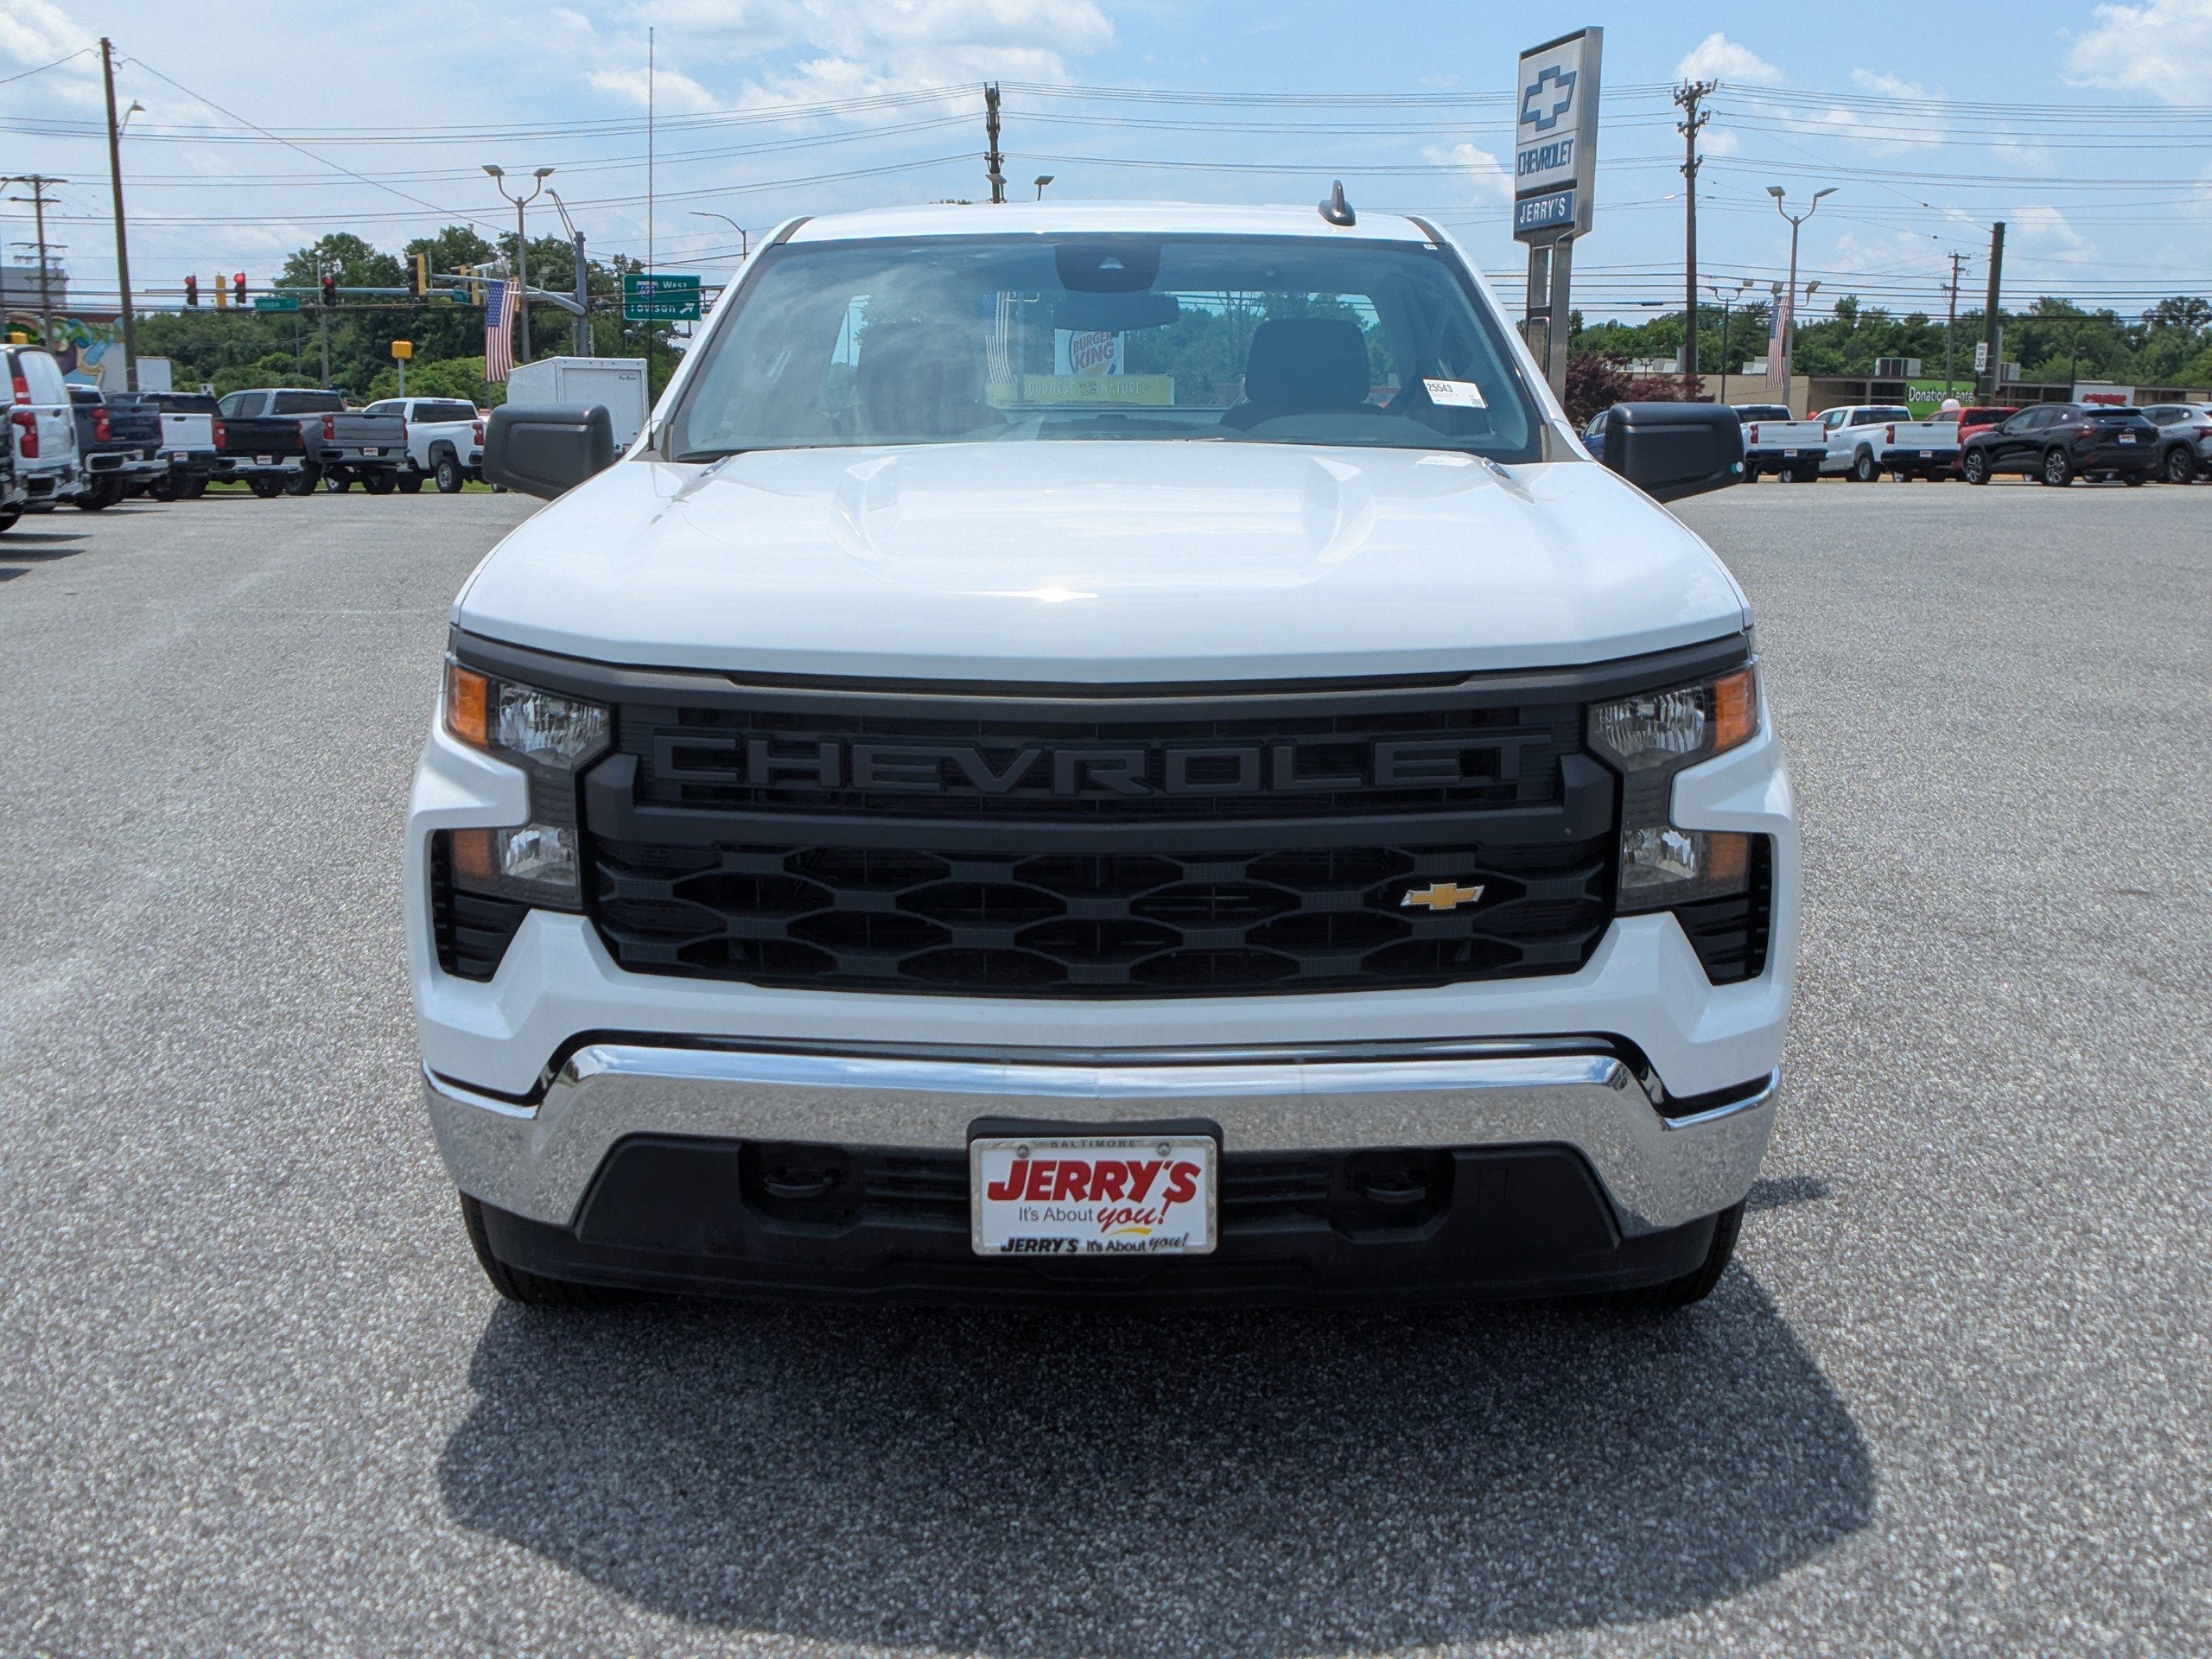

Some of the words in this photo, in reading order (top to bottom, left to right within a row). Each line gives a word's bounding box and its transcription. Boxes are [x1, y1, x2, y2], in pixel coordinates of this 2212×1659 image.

[1518, 138, 1573, 176] CHEVROLET
[1520, 197, 1566, 224] JERRY'S
[1073, 330, 1113, 355] BURGER
[1074, 341, 1115, 372] KING
[1427, 383, 1453, 393] 25543
[1951, 386, 1976, 403] ente
[652, 733, 1552, 795] CHEVROLET
[1051, 1140, 1136, 1148] BALTIMORE
[988, 1159, 1202, 1204] JERRY'S
[1019, 1206, 1039, 1222] It's
[1043, 1206, 1093, 1222] About
[1096, 1198, 1172, 1234] you!
[1001, 1236, 1081, 1253] JERRY'S
[1086, 1239, 1104, 1252] It's
[1105, 1239, 1146, 1252] About
[1148, 1232, 1190, 1251] you!
